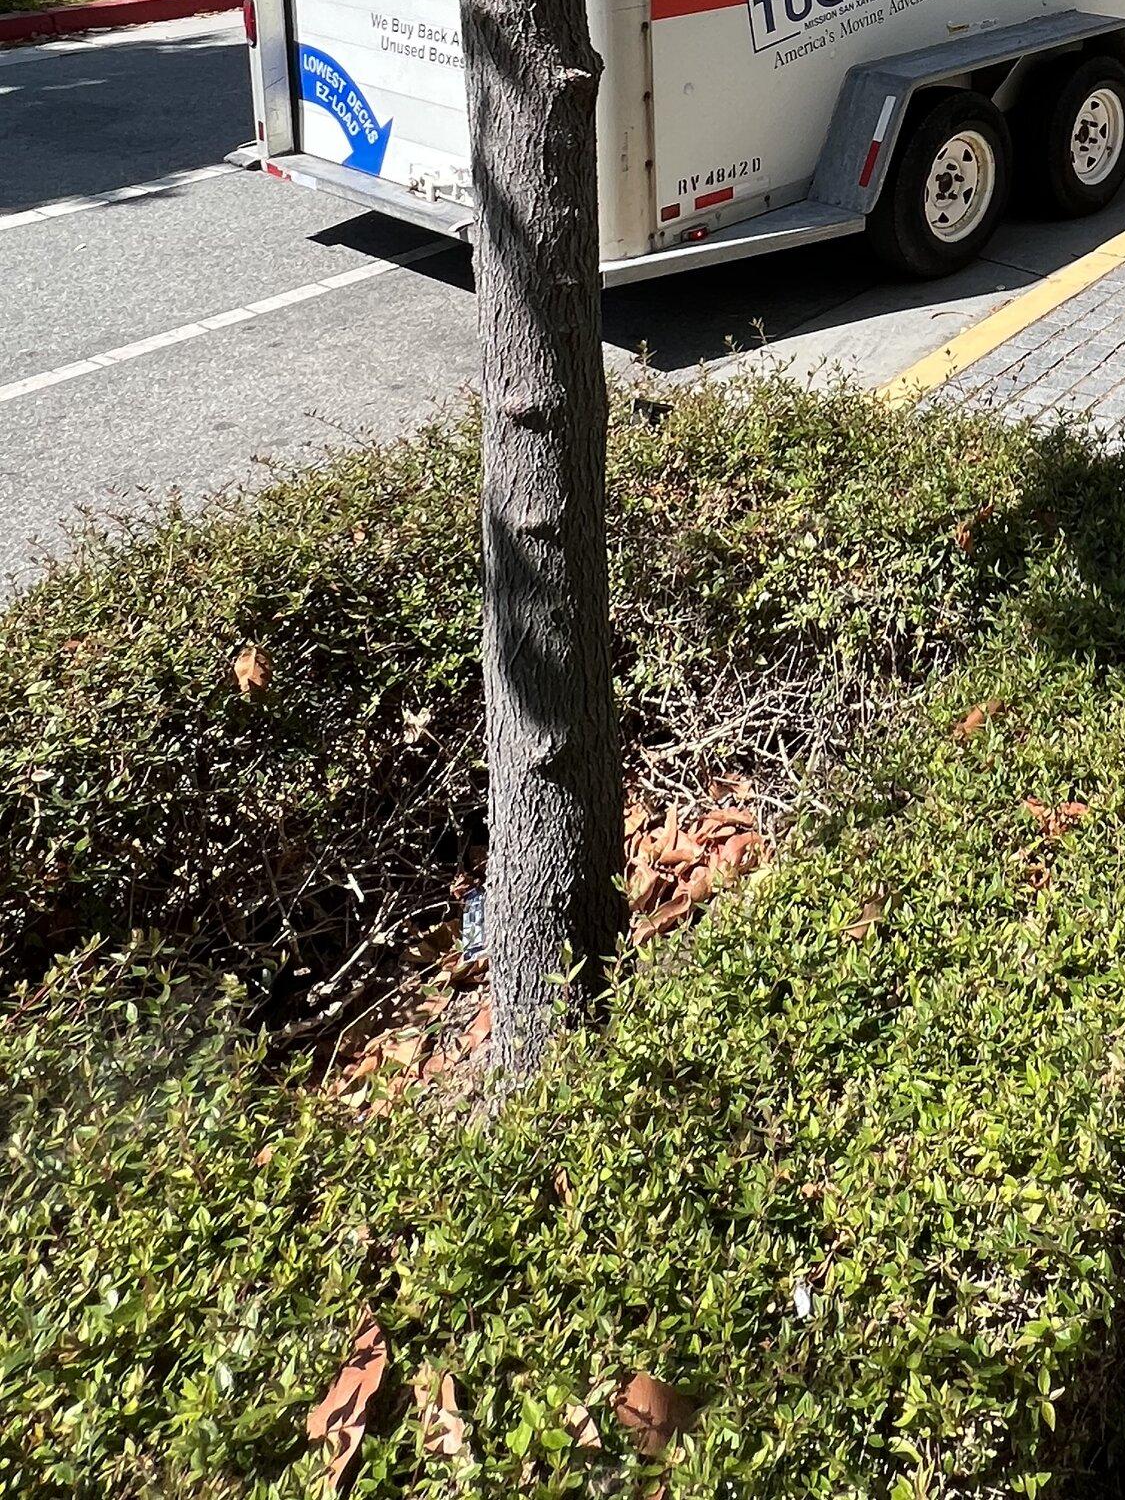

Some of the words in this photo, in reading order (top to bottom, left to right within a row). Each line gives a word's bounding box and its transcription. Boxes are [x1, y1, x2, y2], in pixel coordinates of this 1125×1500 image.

[370, 12, 388, 30] We
[391, 18, 414, 40] Buy
[418, 24, 447, 44] Back
[450, 31, 460, 47] A
[804, 10, 838, 31] MISSION
[839, 3, 855, 16] SAN
[381, 35, 426, 59] Unused
[429, 47, 466, 69] Boxes
[774, 29, 835, 70] America's
[840, 8, 885, 39] Moving
[303, 53, 347, 93] LOWEST
[346, 90, 379, 145] DECKS
[315, 80, 361, 136] EZ-LOAD
[678, 174, 700, 195] RV
